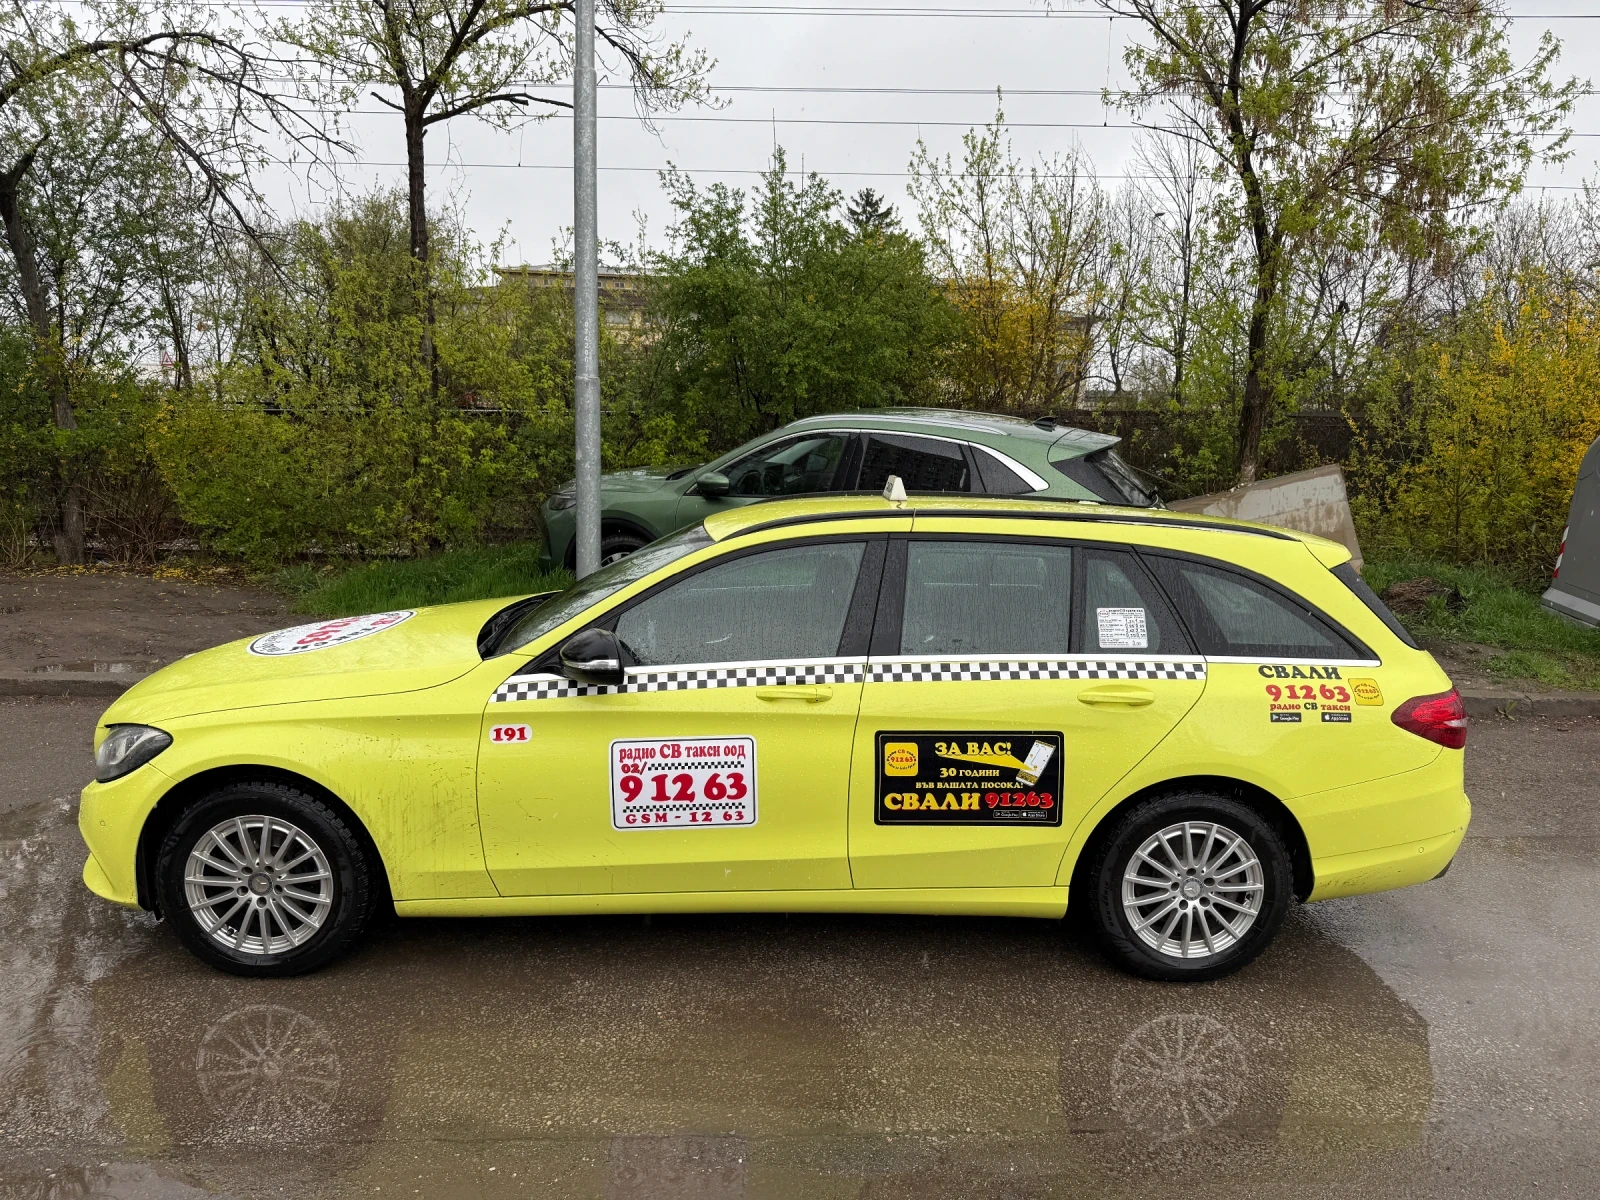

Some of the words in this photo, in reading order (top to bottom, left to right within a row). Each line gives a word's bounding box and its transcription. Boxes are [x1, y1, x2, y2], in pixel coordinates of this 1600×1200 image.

[1258, 665, 1342, 680] СВАЛИ
[1304, 702, 1318, 710] СВ
[492, 727, 528, 741] 191
[619, 748, 656, 763] радио
[660, 744, 682, 759] СВ
[685, 746, 720, 757] такси
[724, 745, 746, 760] оод
[934, 742, 962, 755] ЗА
[966, 742, 1012, 756] ВАС!
[621, 762, 647, 775] 02/
[940, 768, 956, 778] 30
[884, 792, 981, 810] СВАЛИ
[984, 792, 1054, 809] 91263
[626, 813, 668, 824] GSM
[689, 812, 712, 822] 12
[723, 811, 744, 821] 63
